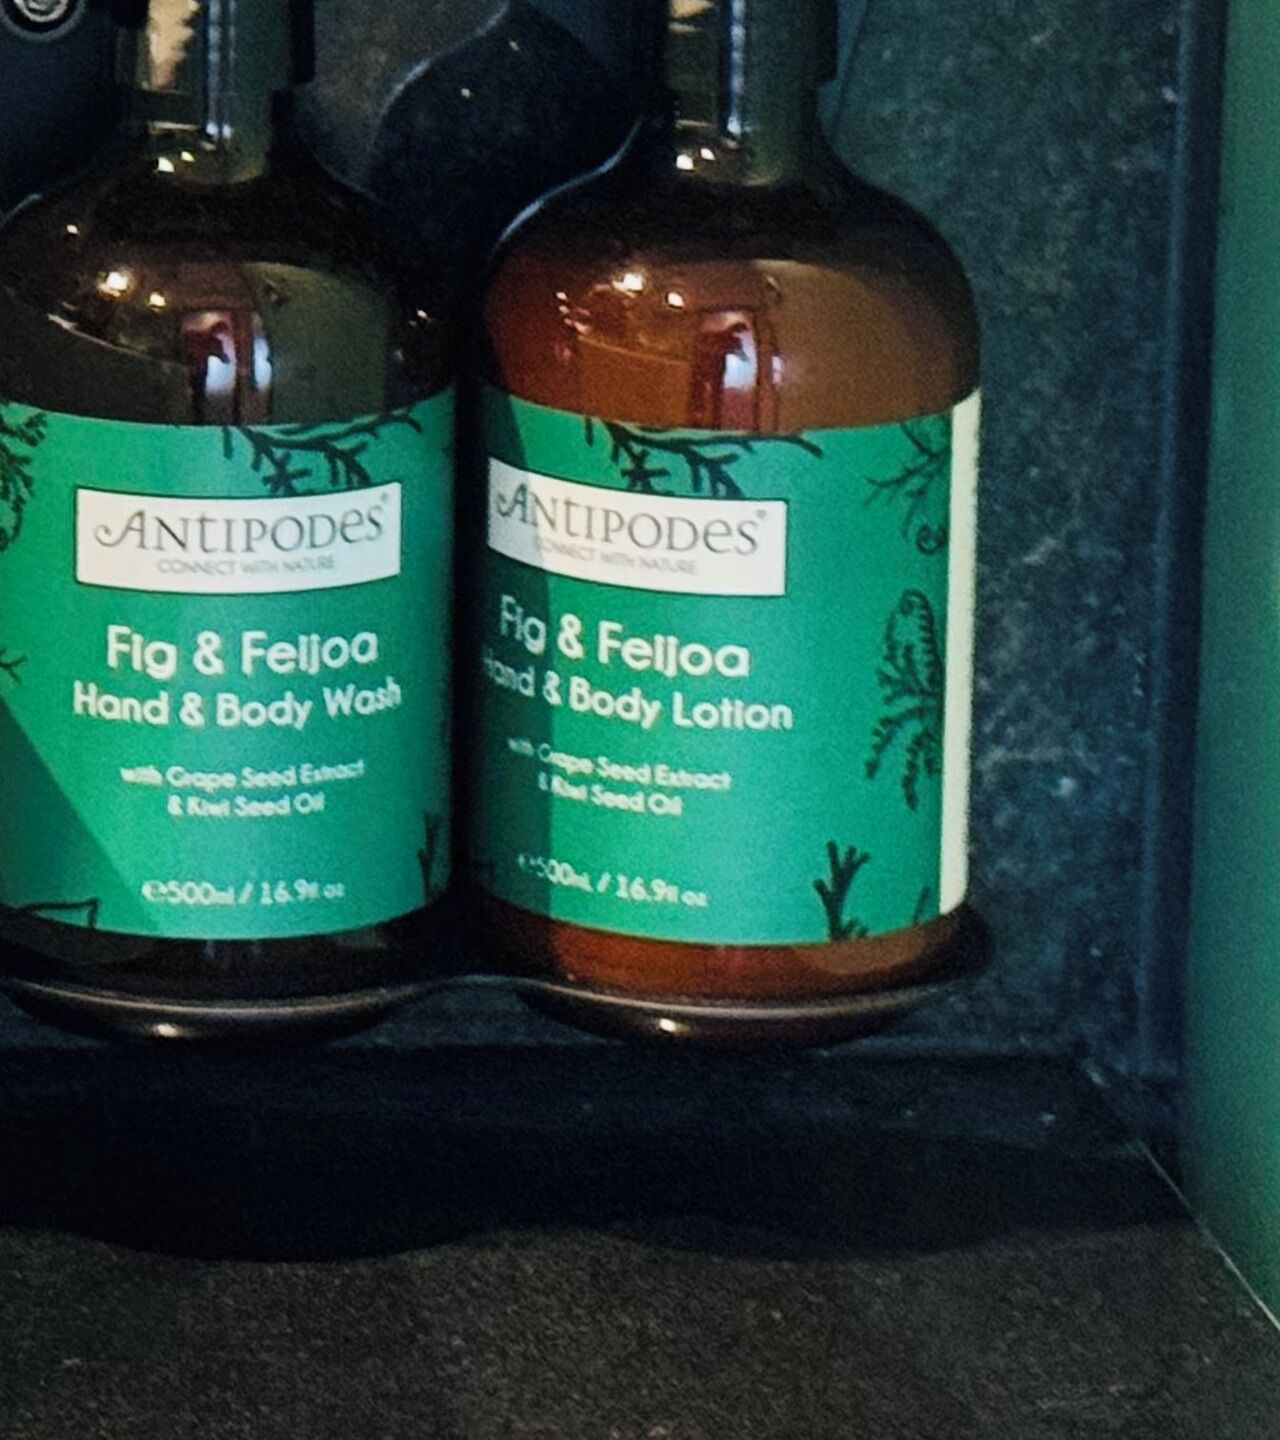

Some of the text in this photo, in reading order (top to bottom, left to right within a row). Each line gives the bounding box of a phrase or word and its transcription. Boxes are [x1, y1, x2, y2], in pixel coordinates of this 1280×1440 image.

[93, 506, 383, 553] ANTIPODES
[495, 483, 759, 556] ANTIPODES
[106, 624, 378, 680] Fig & Feijoa
[500, 594, 751, 678] Fig & Feijoa
[73, 676, 402, 730] Hand & Body Wash
[543, 670, 562, 706] &
[568, 675, 663, 730] Body
[672, 690, 793, 730] Lotion
[166, 765, 237, 792] Grape
[241, 766, 298, 788] Seed
[594, 756, 652, 785] Seed
[653, 763, 732, 790] Extract
[167, 794, 184, 816] &
[233, 795, 291, 817] Seed
[293, 791, 325, 814] Oil
[590, 784, 645, 813] Seed
[647, 792, 683, 816] Oil
[239, 880, 254, 904] /
[597, 871, 611, 893] /
